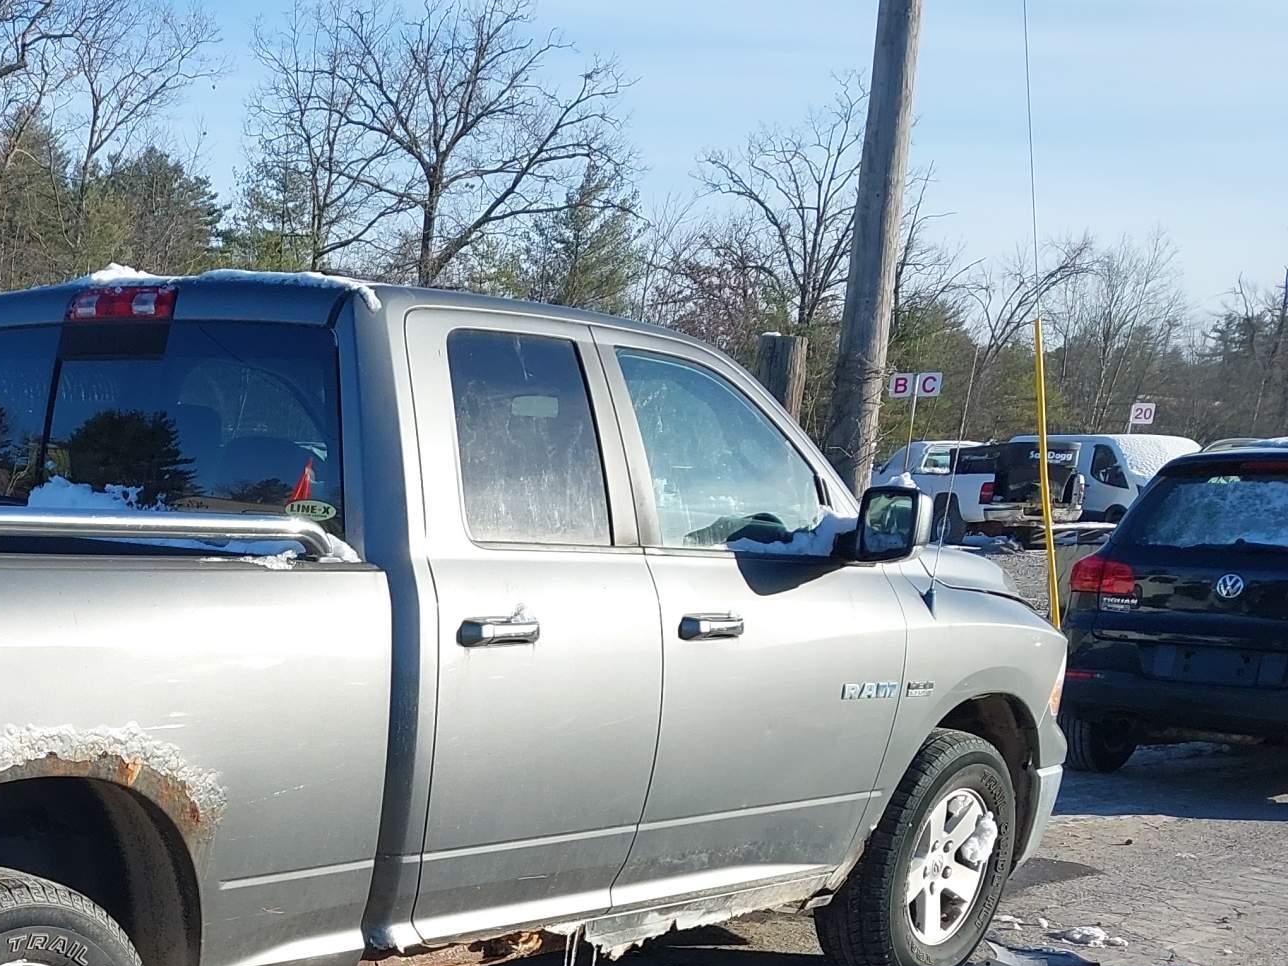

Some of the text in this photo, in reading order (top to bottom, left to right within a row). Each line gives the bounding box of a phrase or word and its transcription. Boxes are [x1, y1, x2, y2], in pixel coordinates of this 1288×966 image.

[894, 377, 908, 393] B
[922, 376, 937, 393] C
[1135, 407, 1153, 420] 20
[1029, 450, 1073, 461] SaDogg
[290, 503, 330, 514] LINE-X
[841, 682, 898, 700] RAM
[8, 933, 89, 966] TRAIL
